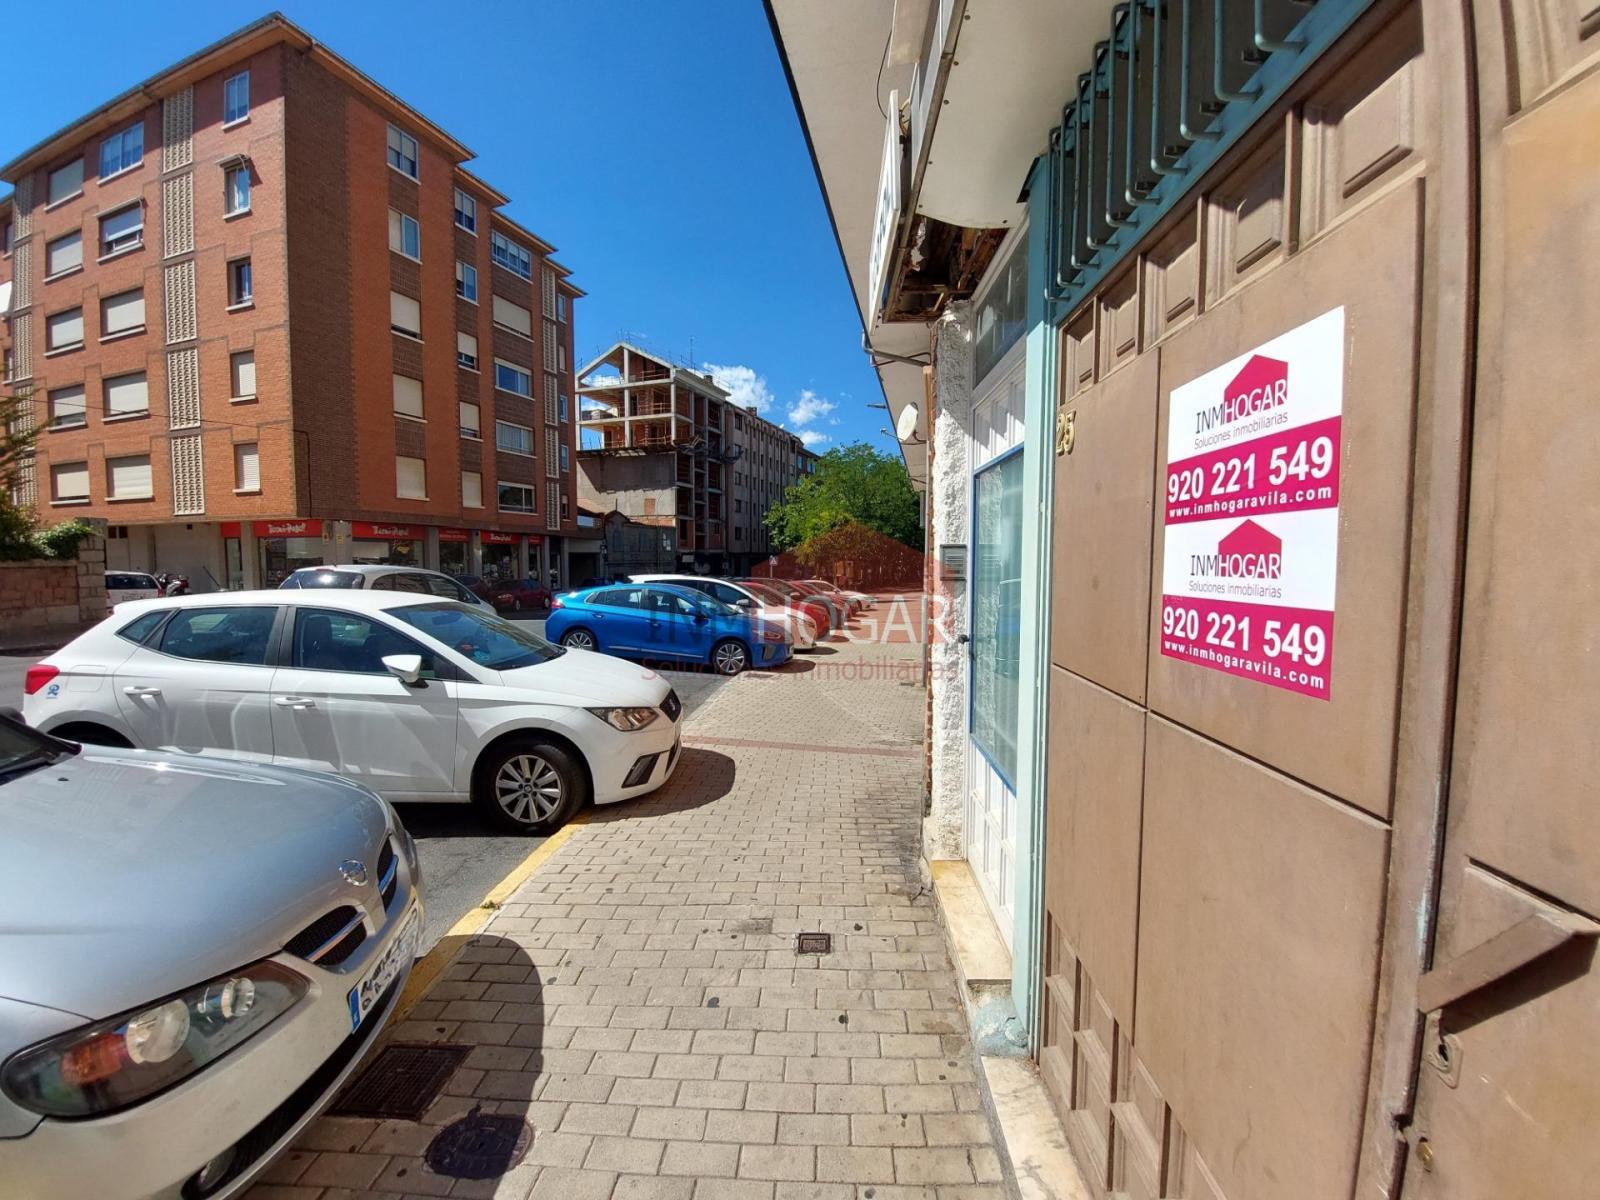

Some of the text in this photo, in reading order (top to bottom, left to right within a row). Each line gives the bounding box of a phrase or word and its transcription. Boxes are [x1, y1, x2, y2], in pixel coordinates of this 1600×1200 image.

[1056, 410, 1076, 456] 25
[1194, 411, 1288, 450] Soluciones inmobiliarias
[1168, 436, 1333, 504] 920 221 549
[1168, 485, 1333, 518] www.inmhogaravila.com
[1190, 552, 1282, 580] INMHOGAR
[1188, 580, 1282, 599] Soluciones inmobiliarias
[1163, 605, 1326, 667] 920 221 549
[1164, 640, 1324, 689] www.inmhogaravila.com
